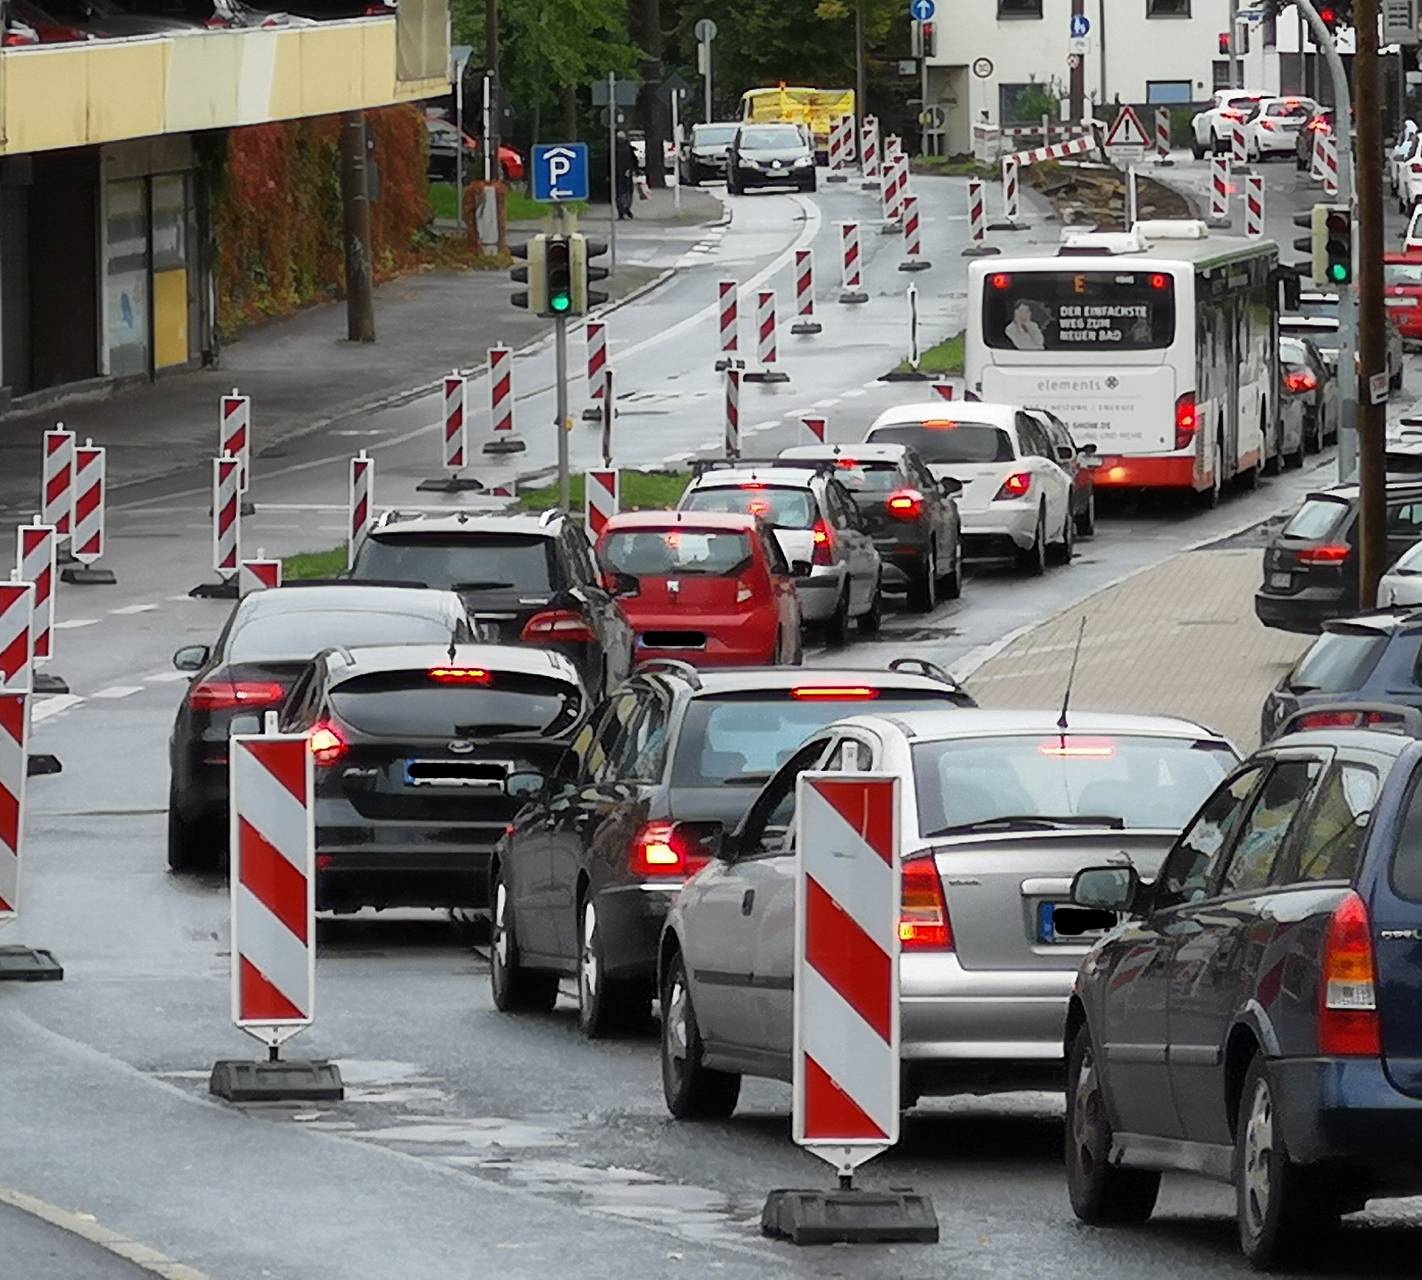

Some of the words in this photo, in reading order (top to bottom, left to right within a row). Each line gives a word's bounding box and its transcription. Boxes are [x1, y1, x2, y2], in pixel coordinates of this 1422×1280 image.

[550, 156, 571, 186] P
[1060, 306, 1083, 317] DER
[1084, 306, 1148, 318] EINFACHSTE
[1060, 318, 1085, 329] WEG
[1086, 318, 1111, 328] ZUM
[1060, 331, 1097, 341] NEUEN
[1098, 331, 1123, 341] BAD
[1037, 379, 1101, 391] elements
